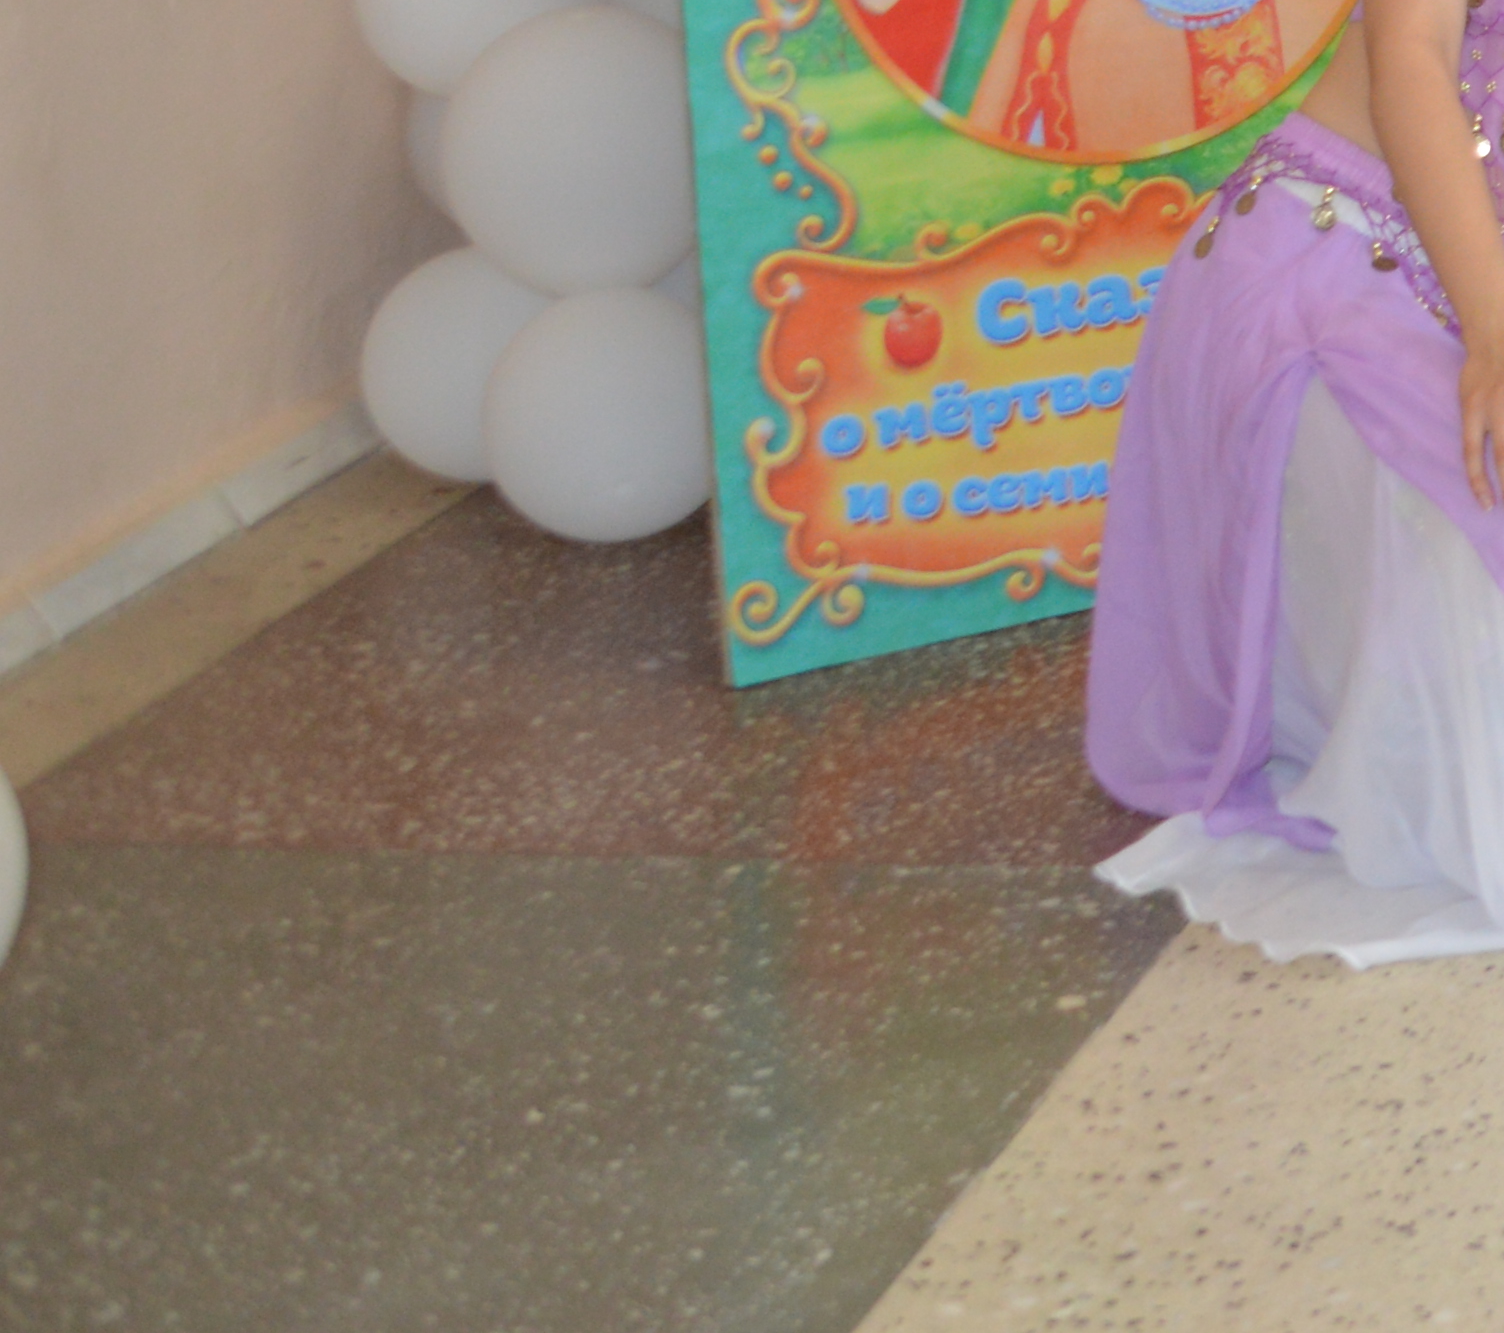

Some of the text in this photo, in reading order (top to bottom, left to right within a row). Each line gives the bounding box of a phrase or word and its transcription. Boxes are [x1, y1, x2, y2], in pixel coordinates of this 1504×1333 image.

[820, 364, 1135, 457] о мёртво
[844, 460, 1110, 523] и о семи
